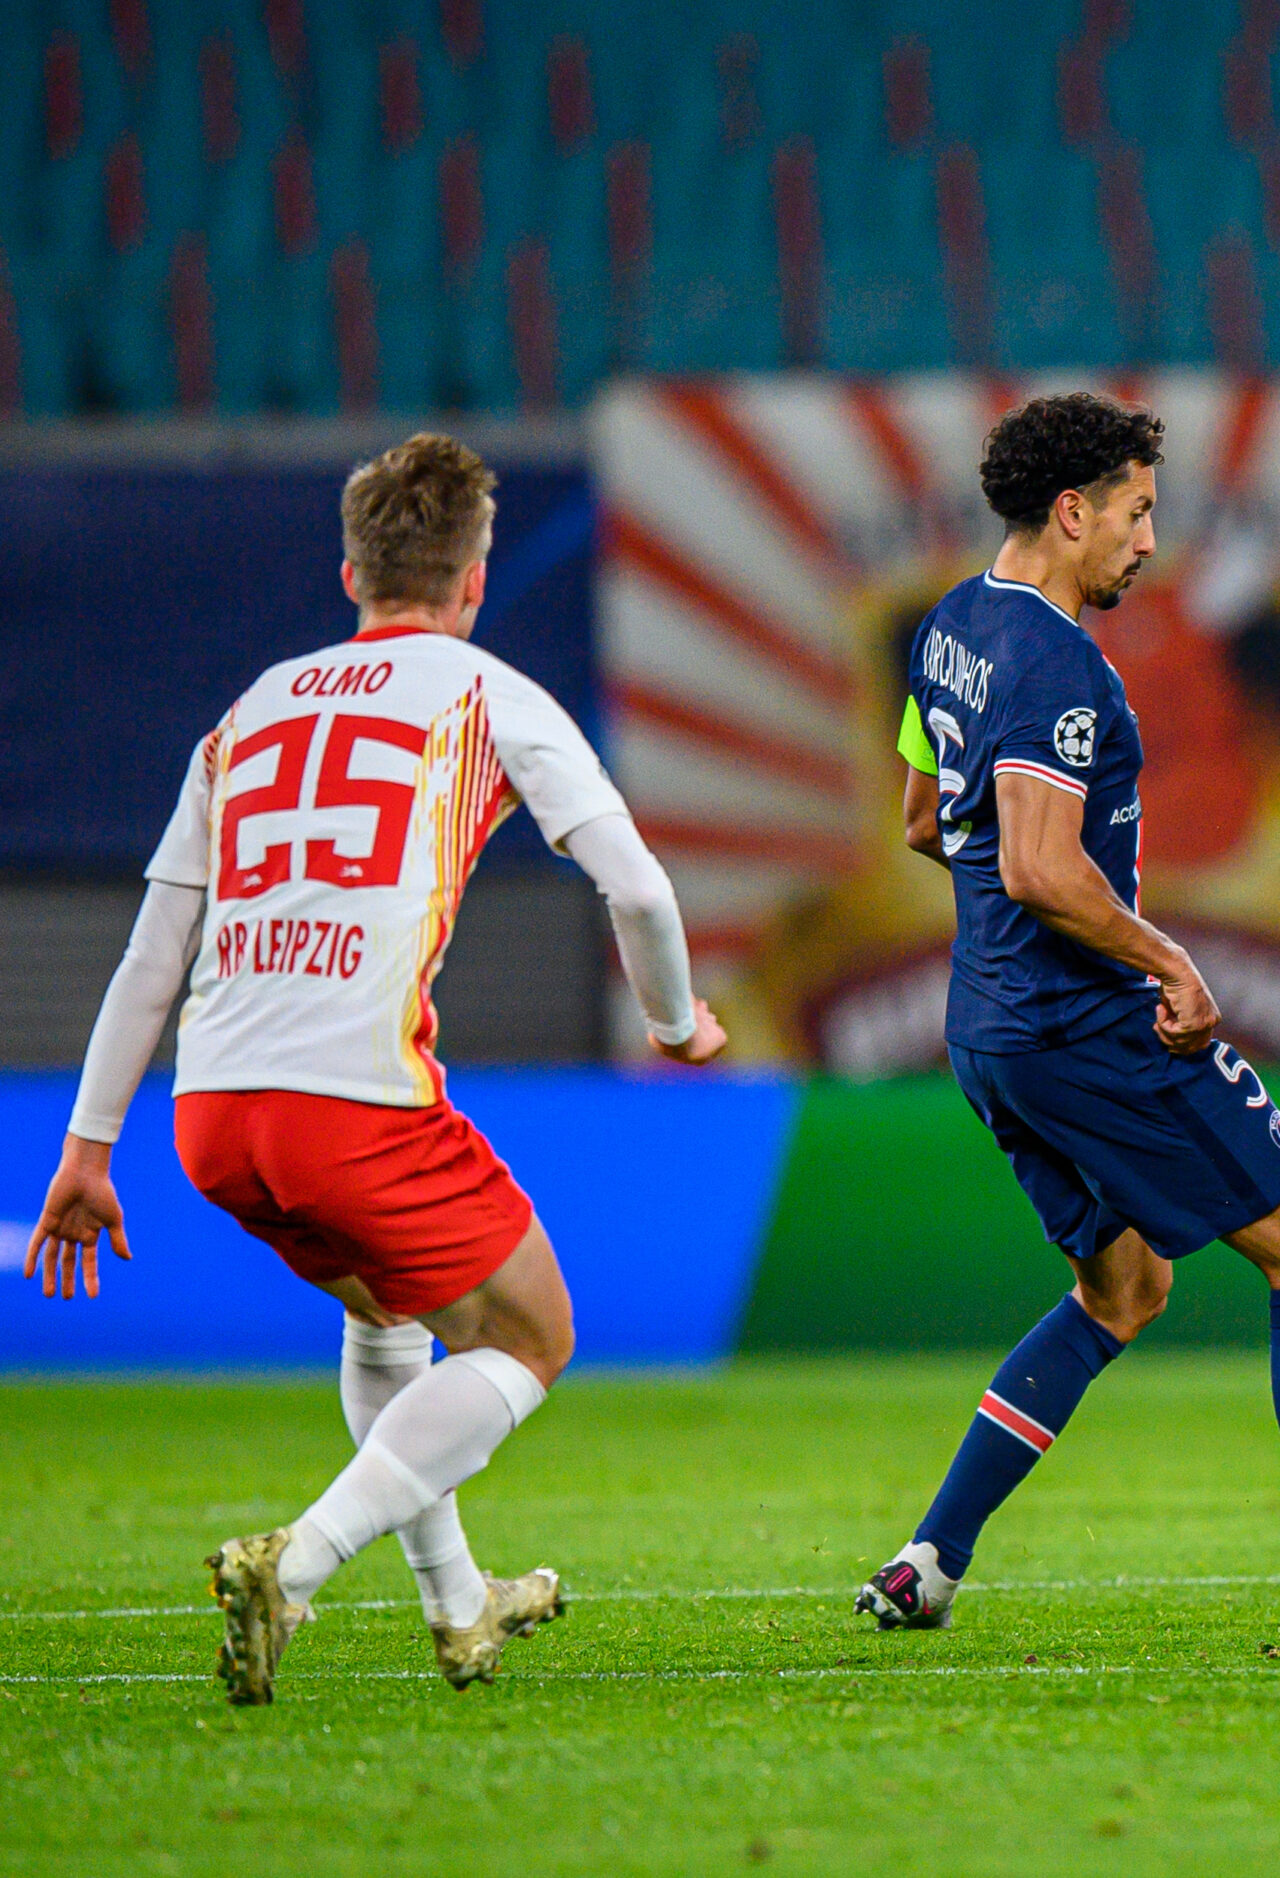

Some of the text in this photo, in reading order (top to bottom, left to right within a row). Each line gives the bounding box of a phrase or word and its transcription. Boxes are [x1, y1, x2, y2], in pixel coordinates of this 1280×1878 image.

[291, 661, 393, 698] OLMO
[217, 713, 429, 902] 25
[253, 918, 364, 980] LEIPZIG
[1214, 1042, 1268, 1108] 5
